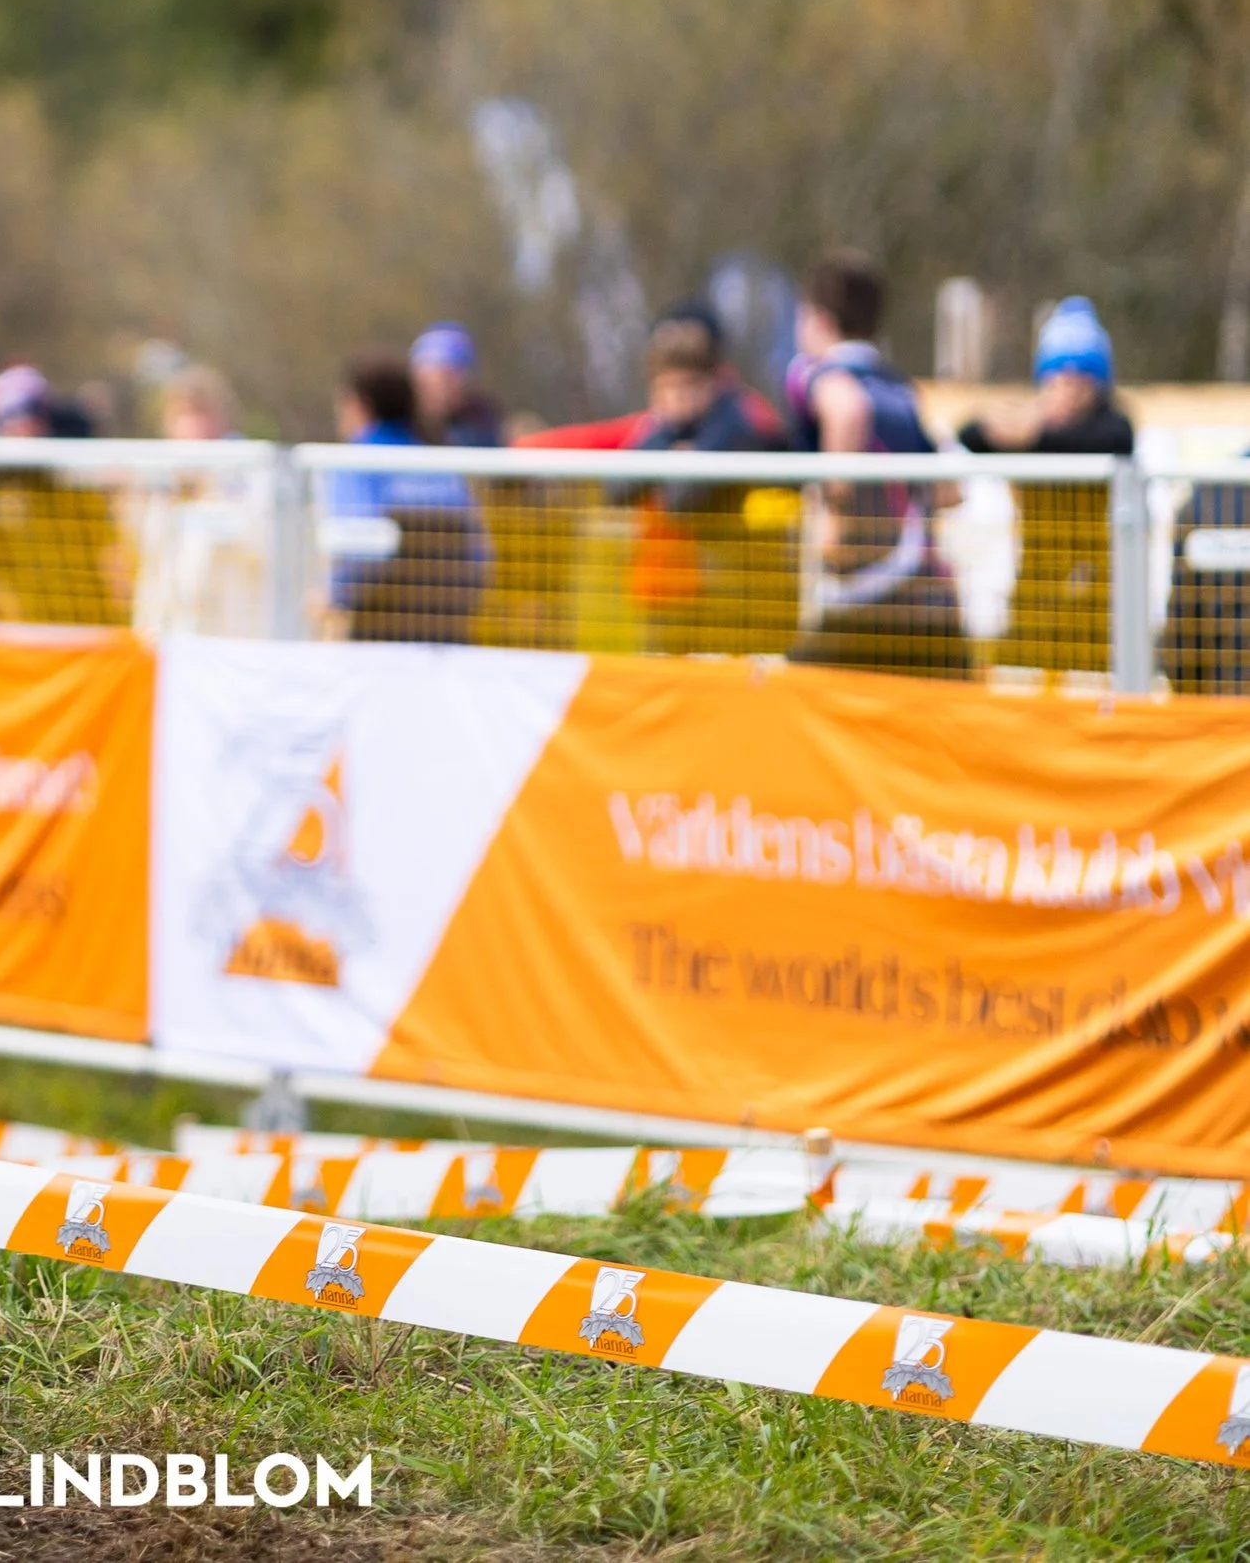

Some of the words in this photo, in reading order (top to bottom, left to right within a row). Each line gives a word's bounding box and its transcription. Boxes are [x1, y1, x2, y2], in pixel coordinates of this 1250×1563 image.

[320, 1226, 360, 1272] 25
[595, 1271, 639, 1319] 25
[900, 1319, 947, 1370] 25
